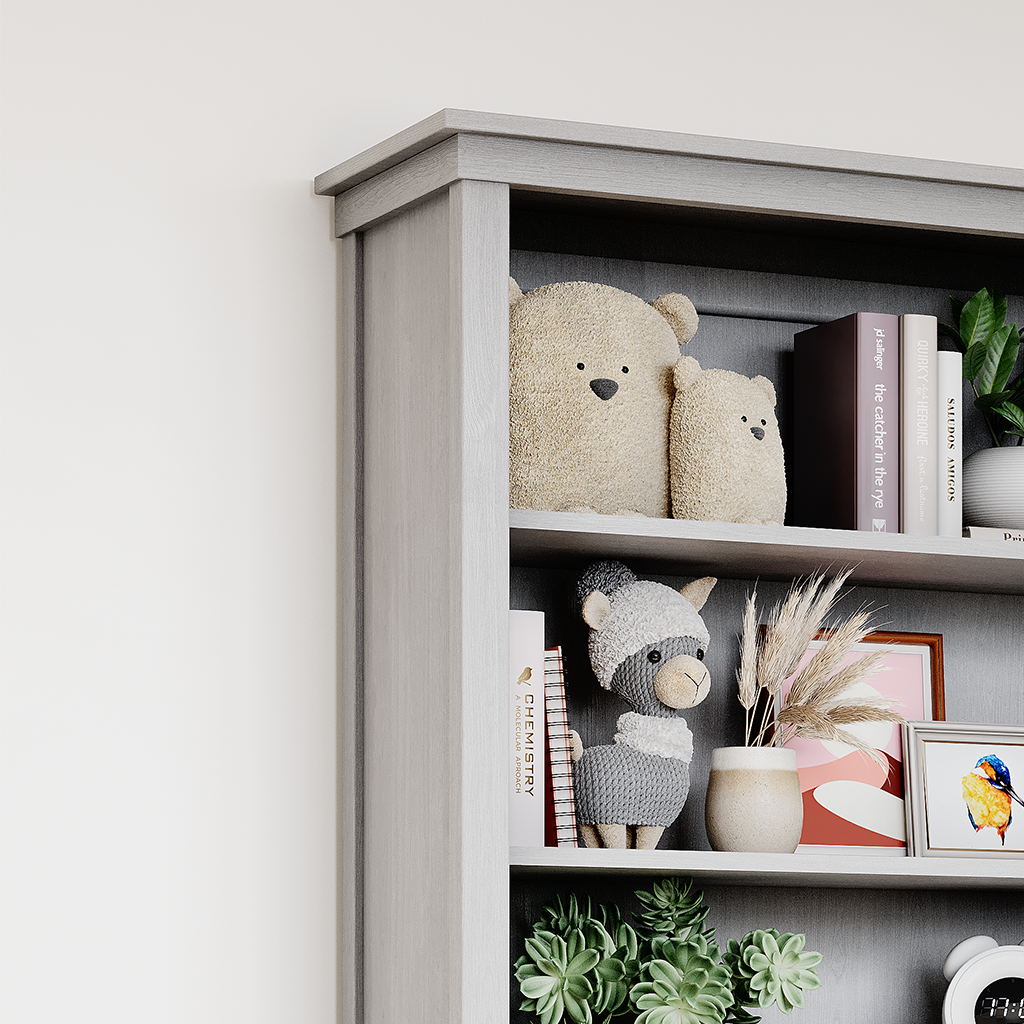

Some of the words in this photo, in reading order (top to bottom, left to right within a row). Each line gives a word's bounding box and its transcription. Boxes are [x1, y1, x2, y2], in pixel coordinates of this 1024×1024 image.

[873, 327, 885, 338] jd
[873, 338, 885, 371] salinger
[917, 339, 929, 383] QUIRKY
[874, 383, 887, 403] the
[874, 405, 887, 451] catcher
[916, 401, 929, 446] HEROINE
[946, 397, 955, 450] SALUDOS
[874, 451, 887, 464] in
[874, 466, 887, 487] the
[946, 456, 955, 502] AMIGOS
[871, 489, 884, 509] rye
[524, 694, 534, 797] CHEMISTRY
